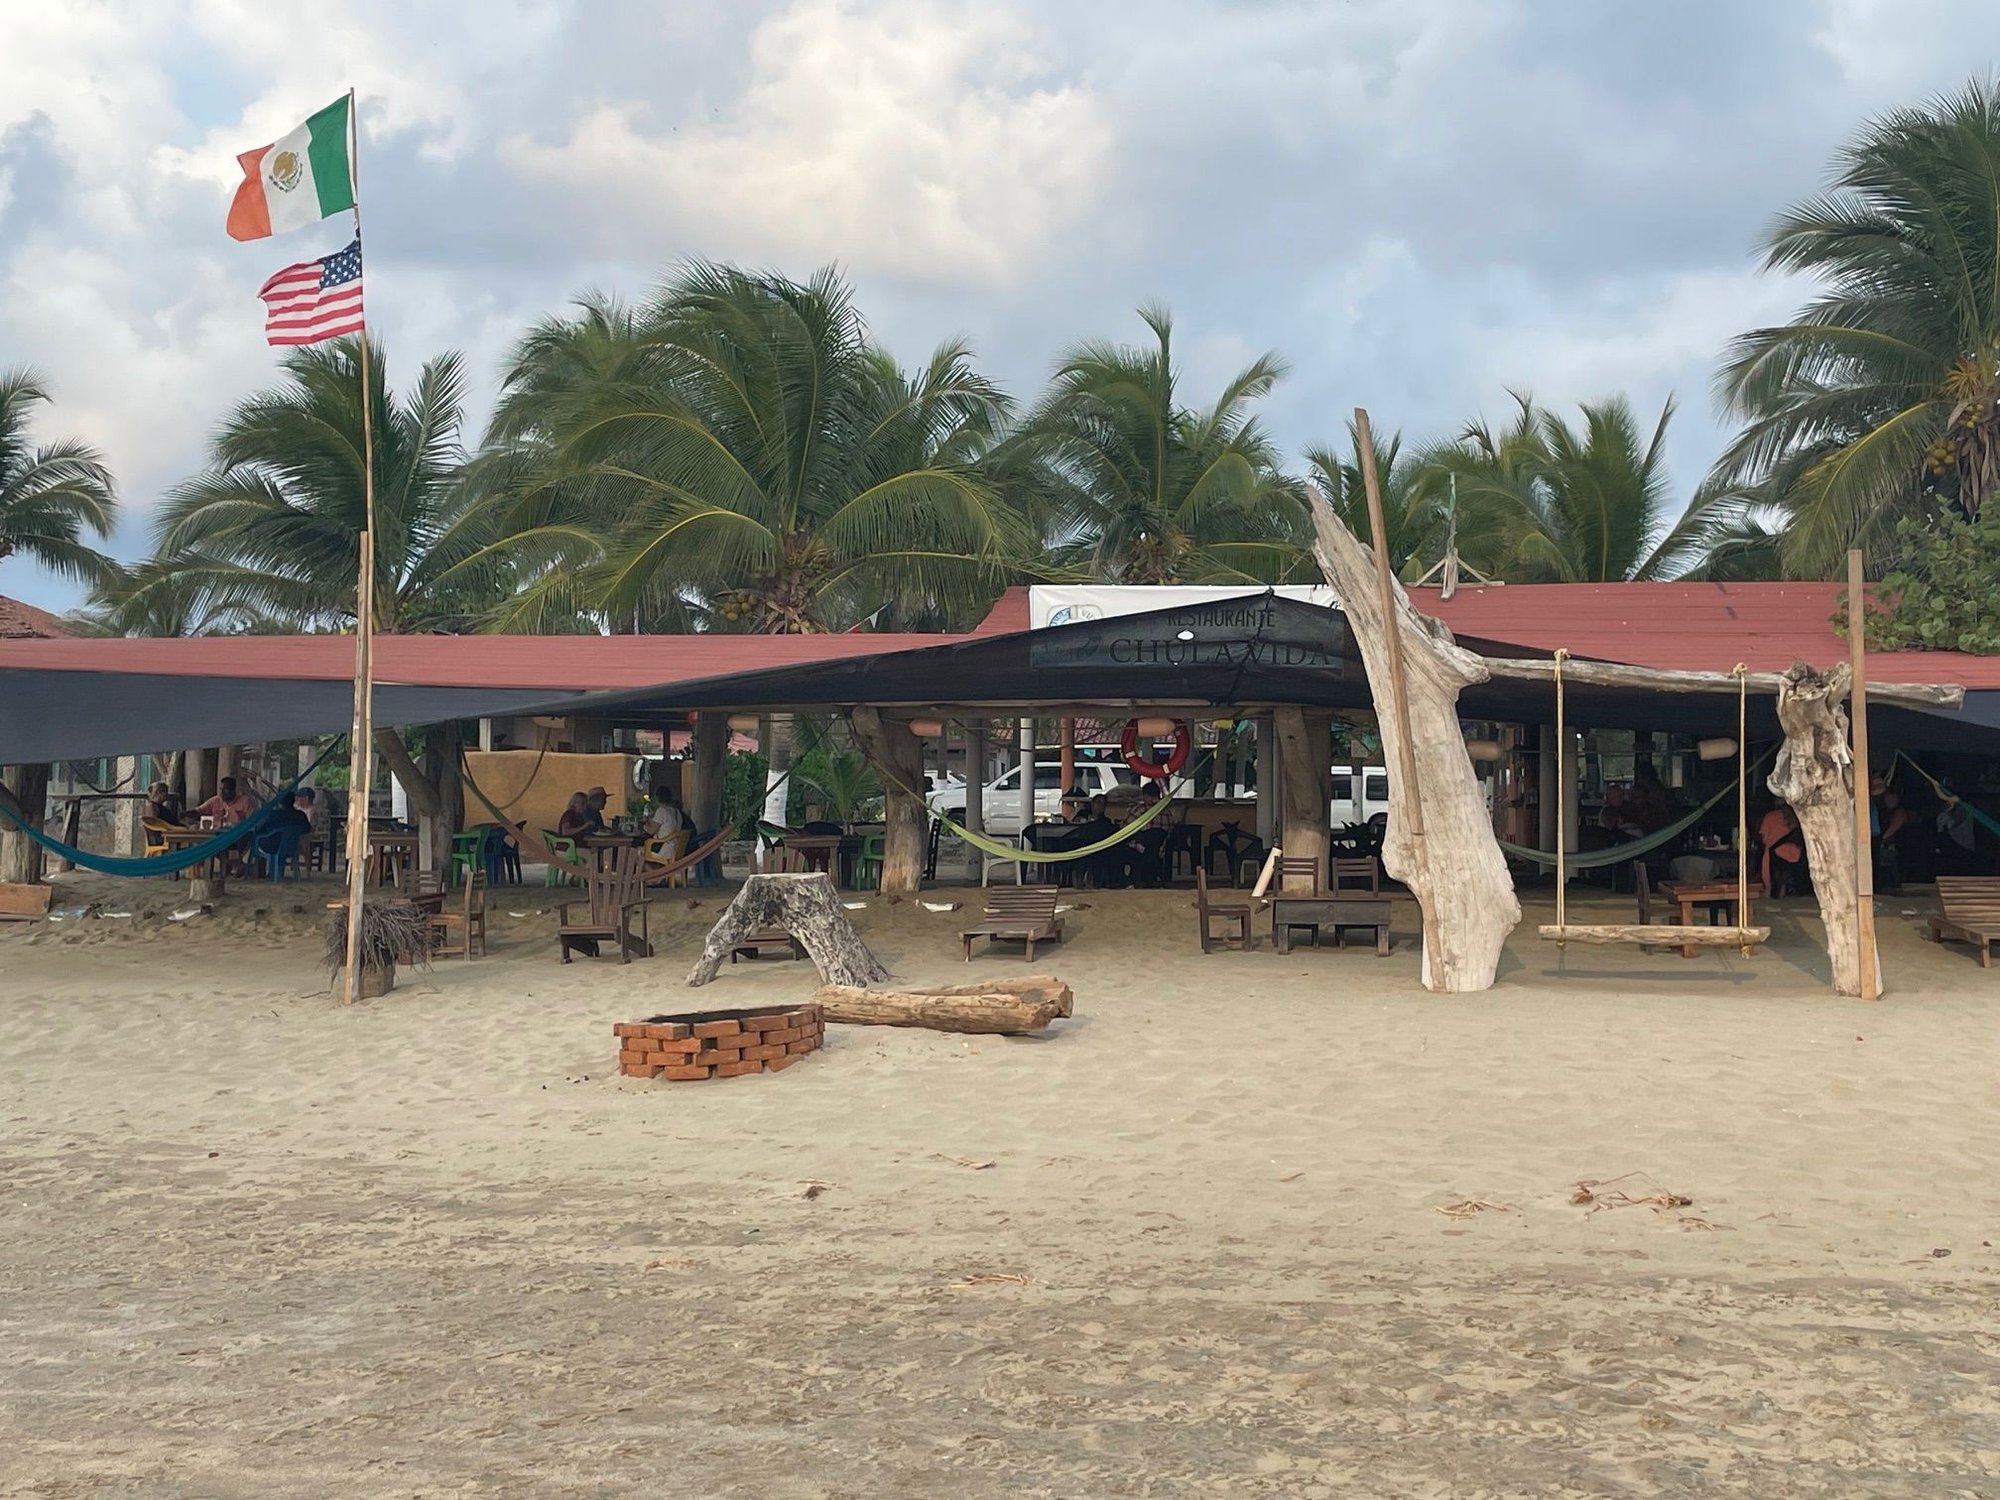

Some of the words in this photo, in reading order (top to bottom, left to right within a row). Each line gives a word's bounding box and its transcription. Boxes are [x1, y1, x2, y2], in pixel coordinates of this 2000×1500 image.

[1168, 609, 1275, 627] RESTAURANTE
[1109, 638, 1235, 664] CHULA
[1244, 639, 1331, 665] VIDA
